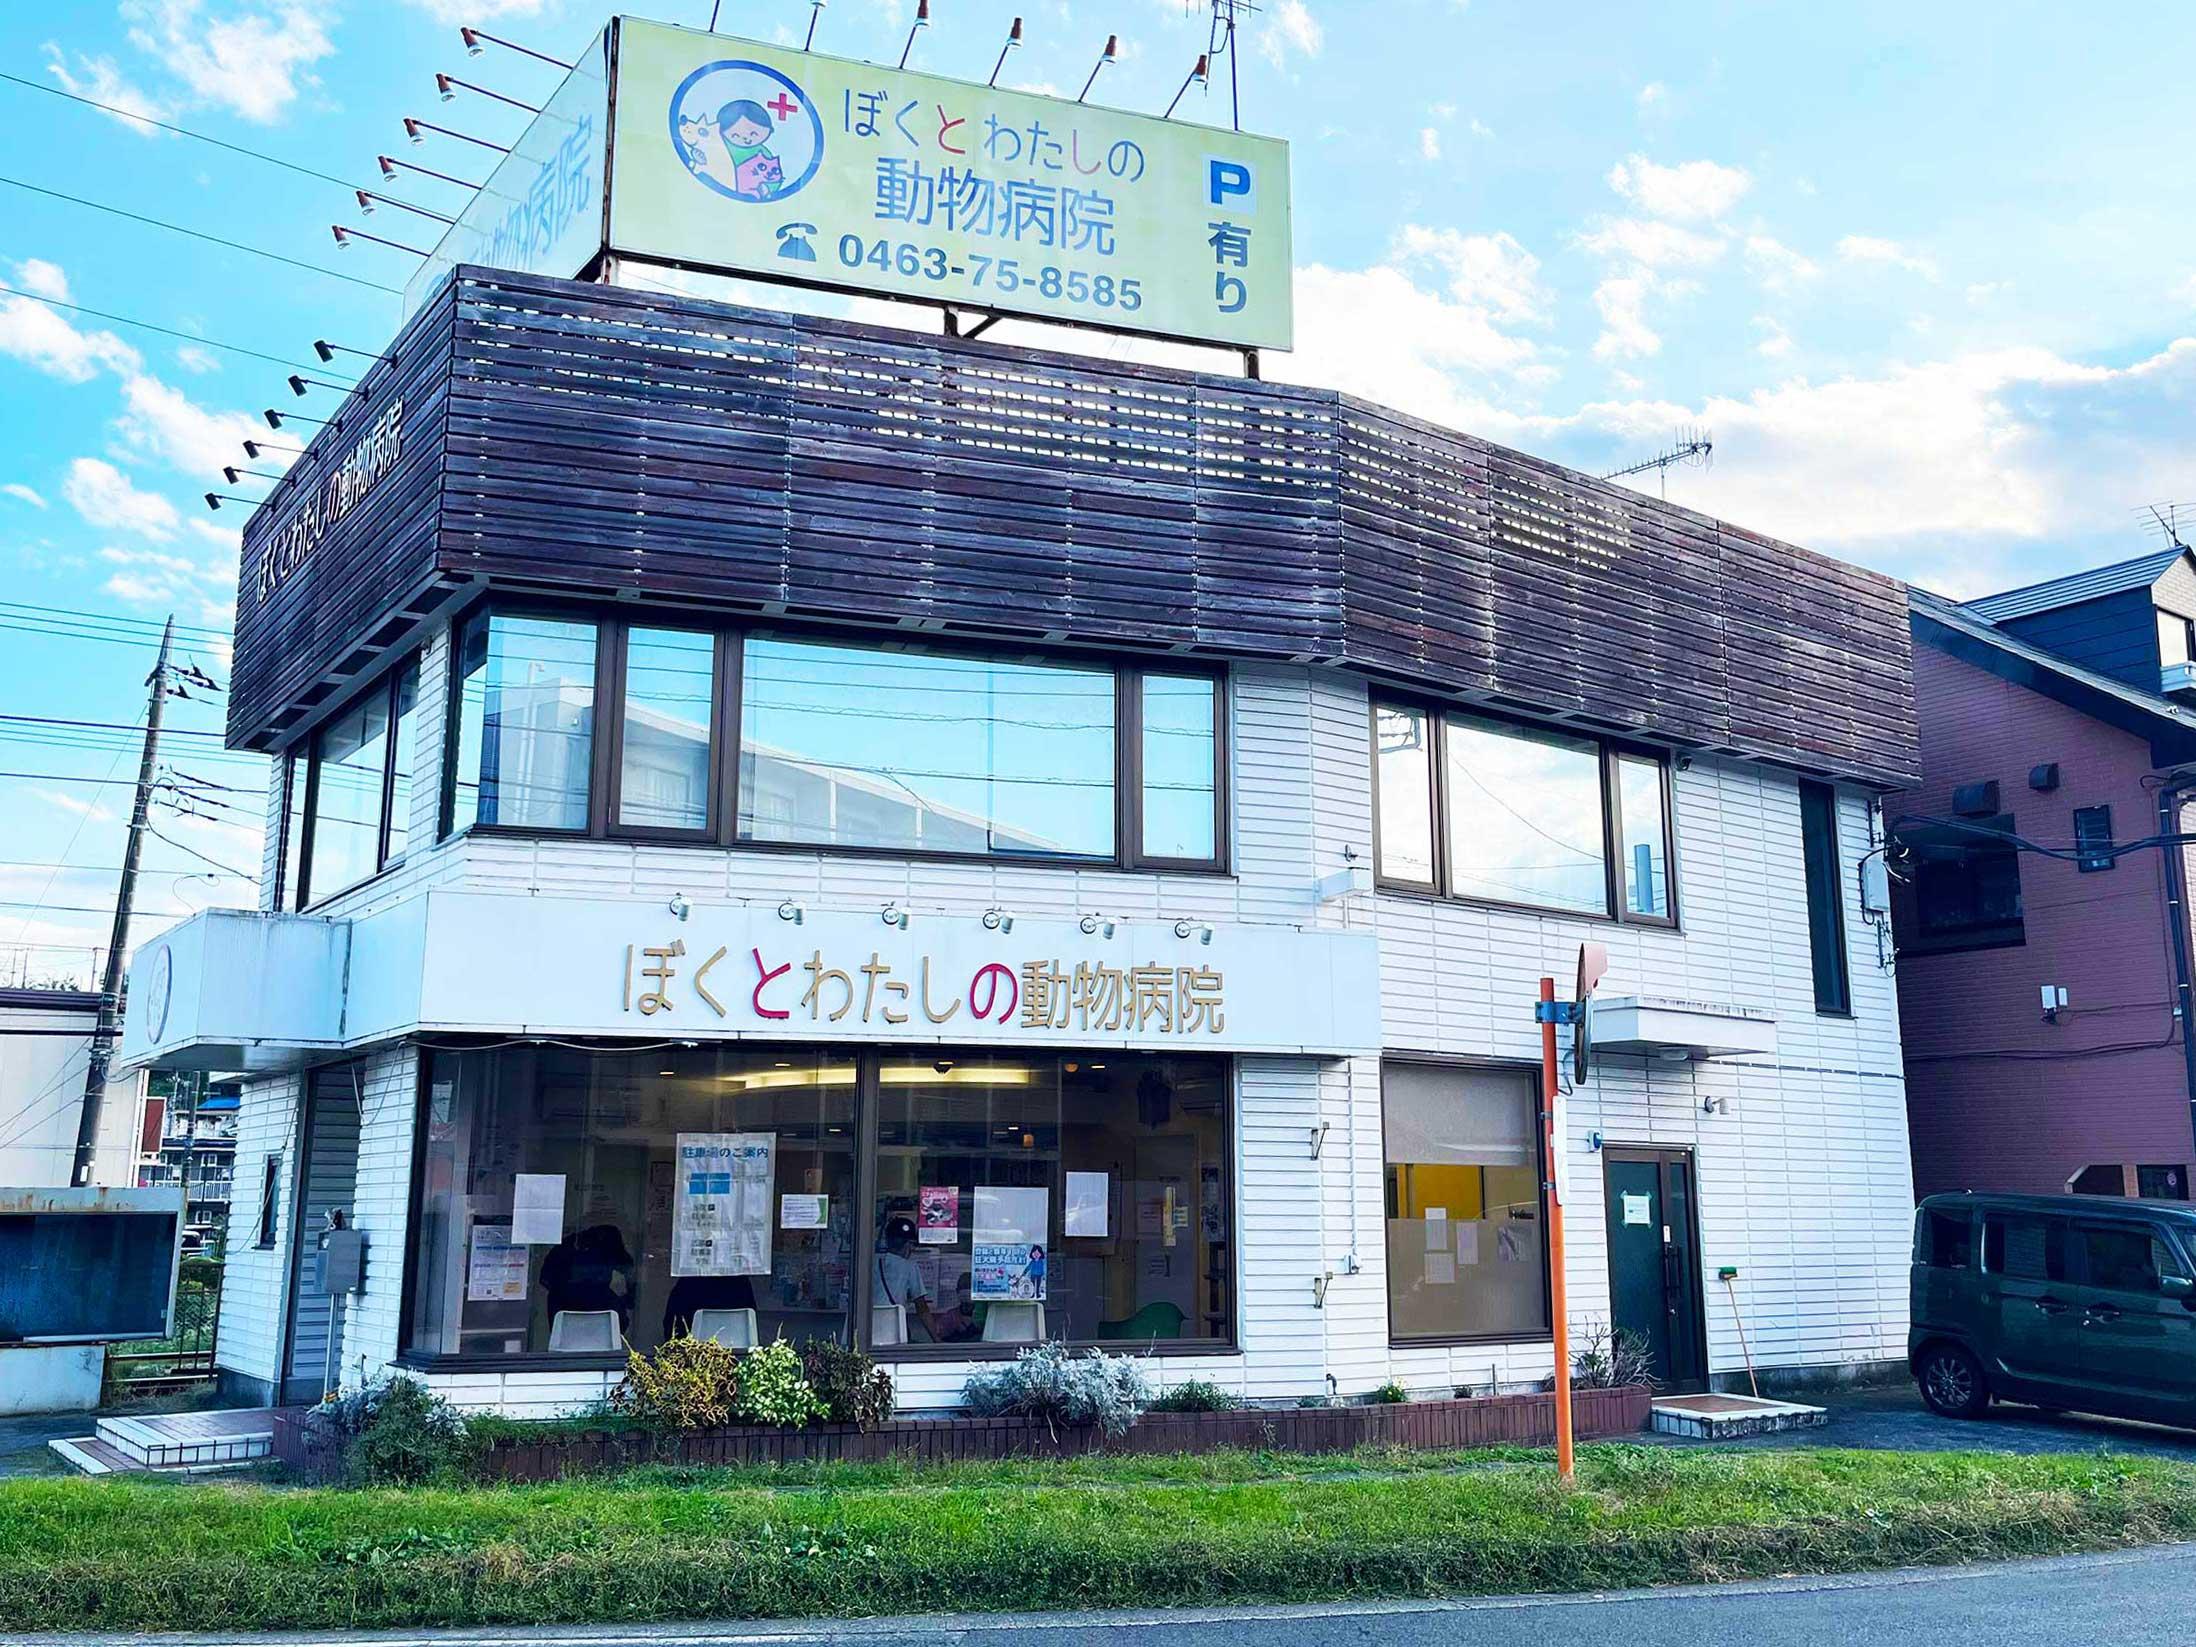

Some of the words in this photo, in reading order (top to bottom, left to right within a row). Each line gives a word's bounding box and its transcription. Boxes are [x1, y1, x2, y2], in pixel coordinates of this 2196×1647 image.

[843, 88, 1146, 184] ぼくとわたしの
[1208, 159, 1252, 206] P
[873, 156, 1117, 257] 動物病院
[837, 233, 1143, 313] 0463-75-8585
[1207, 220, 1251, 314] 有り
[623, 939, 1226, 1034] ぼくとわたしの動物病院
